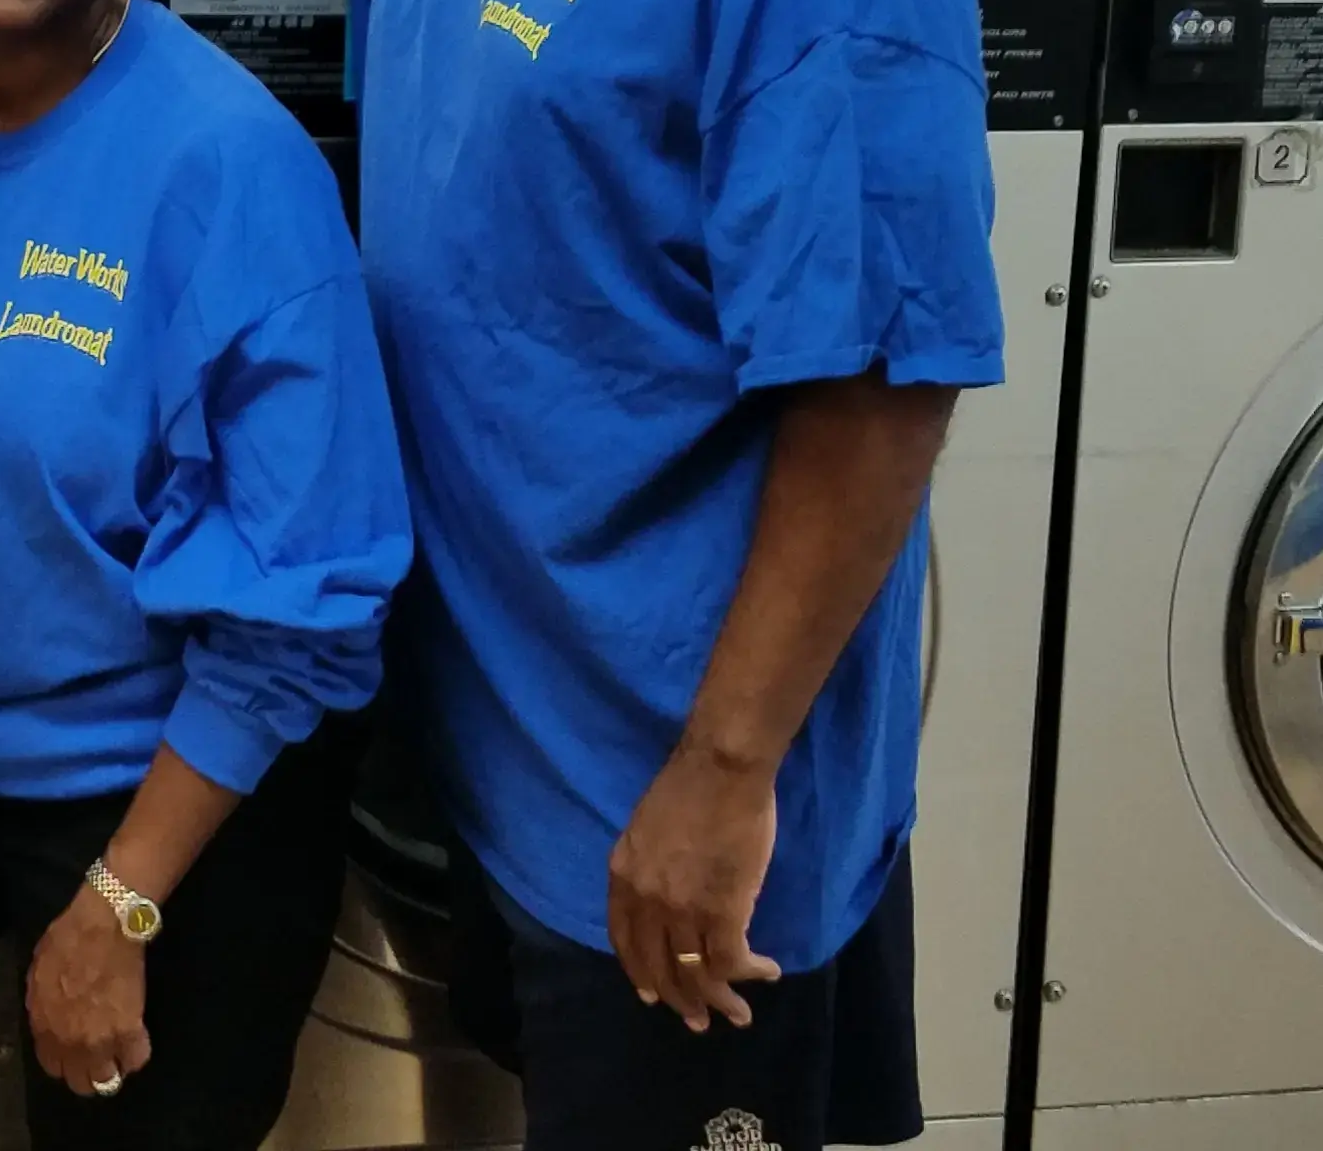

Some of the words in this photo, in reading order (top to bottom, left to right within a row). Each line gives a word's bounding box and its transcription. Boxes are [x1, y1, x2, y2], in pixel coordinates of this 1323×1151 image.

[1274, 144, 1290, 169] 2
[19, 239, 77, 280] Water
[707, 1128, 763, 1145] GOOD
